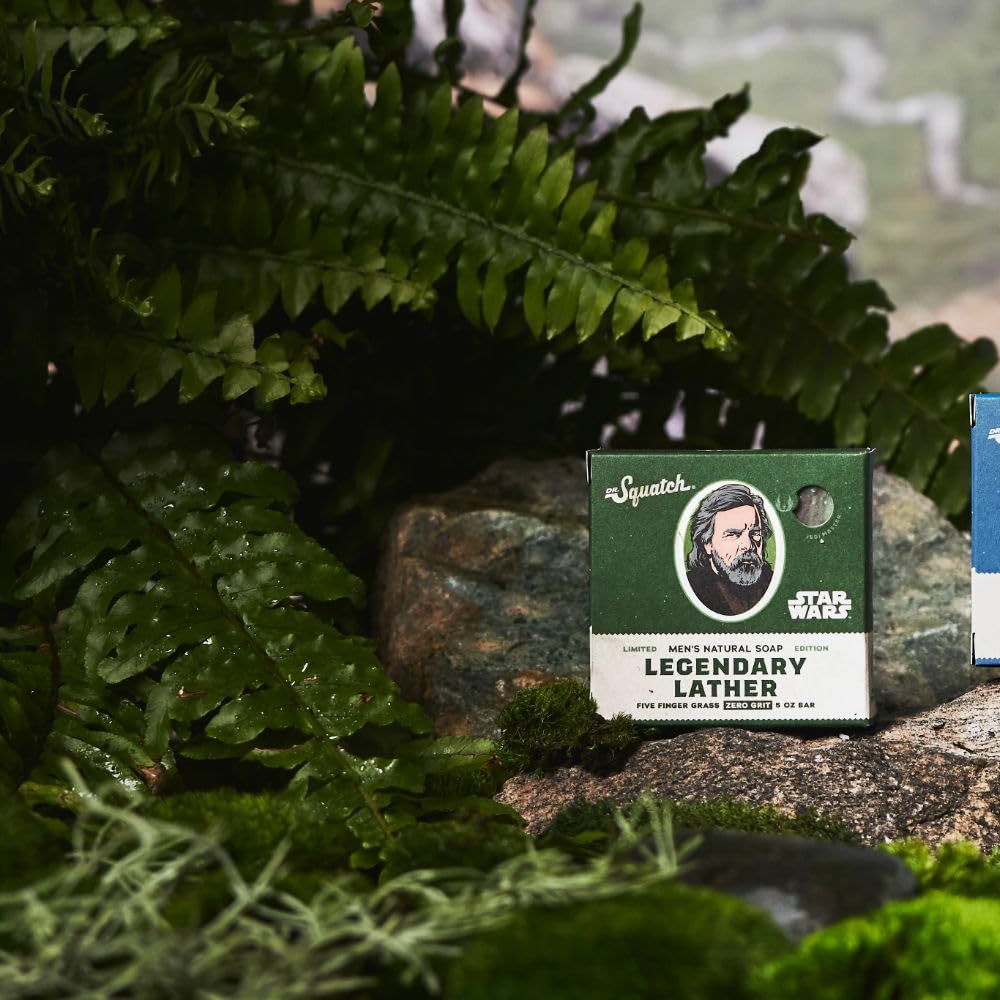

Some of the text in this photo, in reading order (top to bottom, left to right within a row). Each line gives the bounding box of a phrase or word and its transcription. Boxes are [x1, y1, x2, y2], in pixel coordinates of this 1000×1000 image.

[604, 473, 691, 508] Squatch
[788, 590, 852, 605] STAR
[788, 604, 852, 619] WARS
[668, 645, 700, 653] MEN'S
[703, 645, 751, 653] NATURAL
[755, 645, 783, 653] SOAP
[645, 657, 807, 675] LEGENDARY
[674, 679, 777, 697] LATHER
